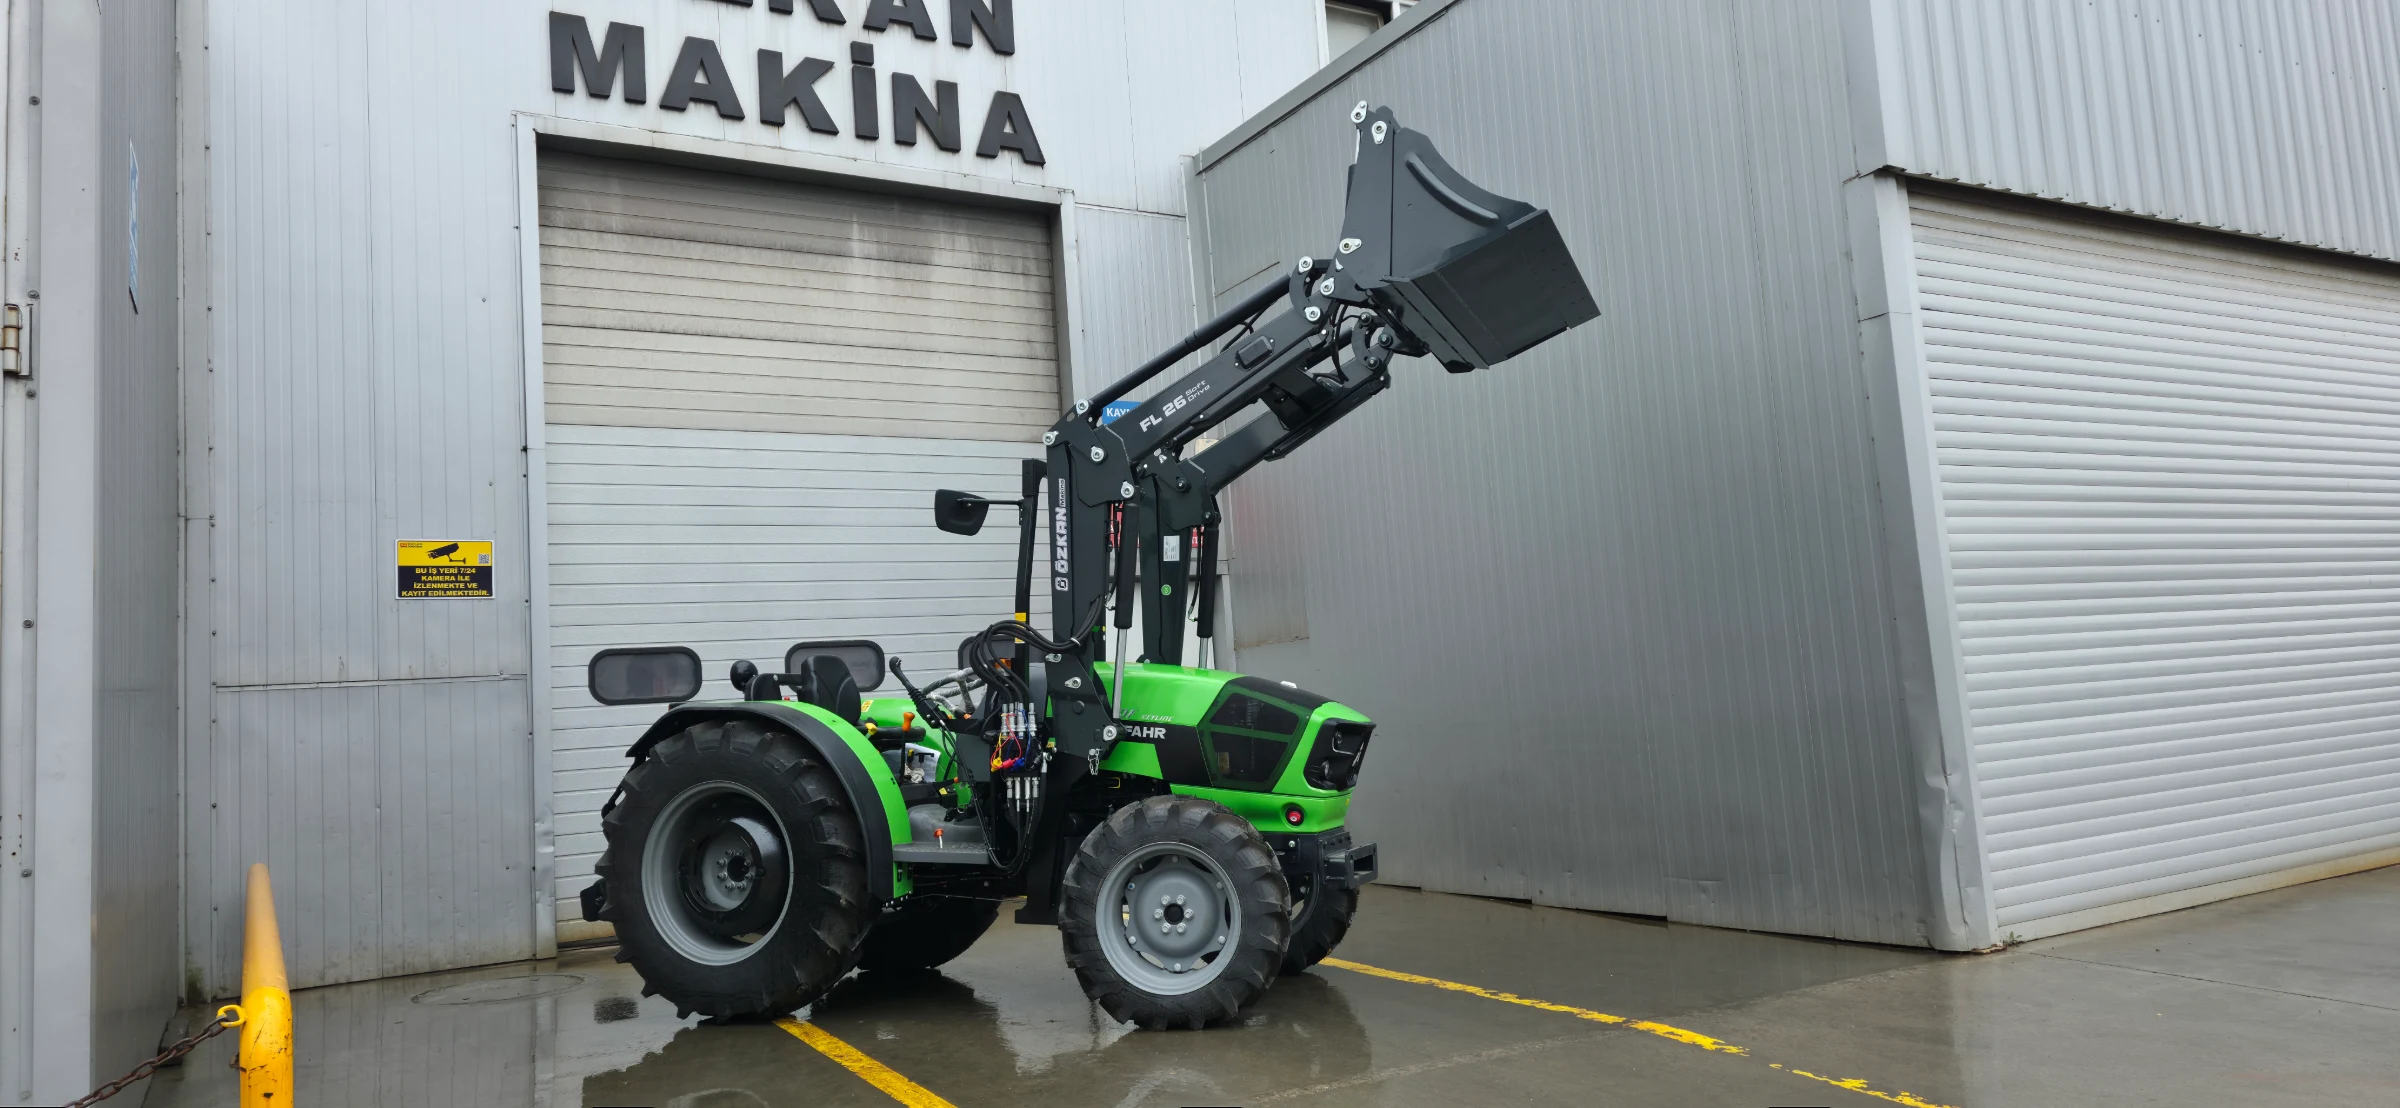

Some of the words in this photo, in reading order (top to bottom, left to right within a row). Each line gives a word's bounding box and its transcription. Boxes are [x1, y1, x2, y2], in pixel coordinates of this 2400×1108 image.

[549, 10, 1046, 168] MAKİNA
[1185, 380, 1206, 397] Soft
[1187, 384, 1211, 402] Drive
[1139, 414, 1163, 433] FL
[1162, 394, 1187, 417] 26
[1055, 506, 1069, 574] ÖZKAN
[428, 566, 437, 575] İŞ
[439, 566, 458, 574] YERİ
[413, 581, 466, 589] İZLENMEKTE
